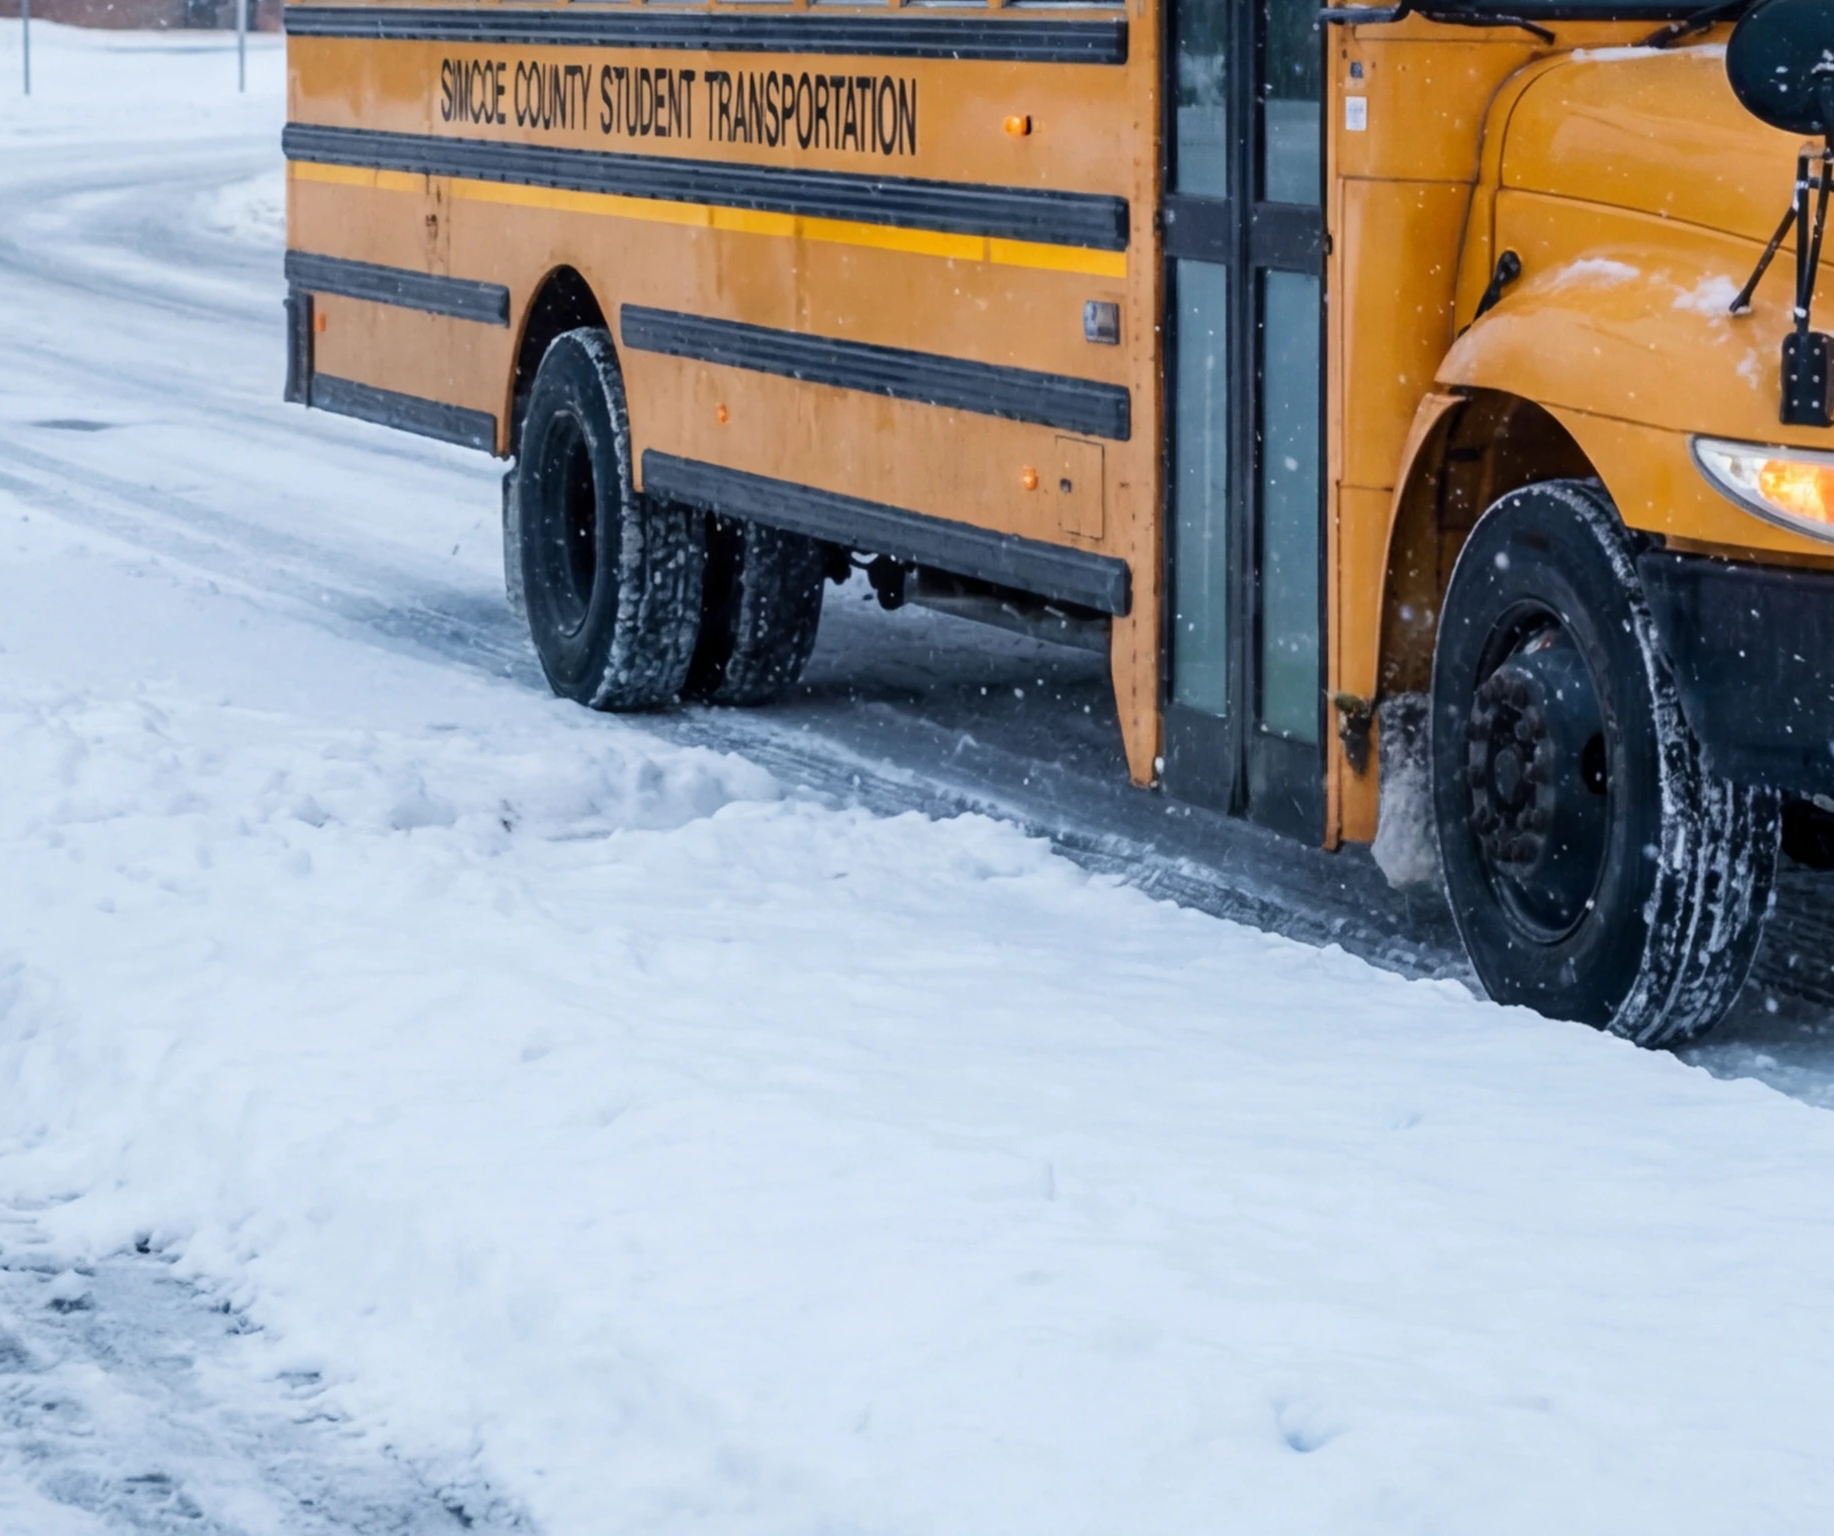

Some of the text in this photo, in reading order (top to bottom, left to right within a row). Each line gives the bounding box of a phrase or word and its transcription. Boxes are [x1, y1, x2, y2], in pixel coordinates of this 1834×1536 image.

[514, 60, 593, 131] COUNTY
[600, 64, 696, 139] STUDENT
[704, 70, 917, 156] TRANSPORTATION
